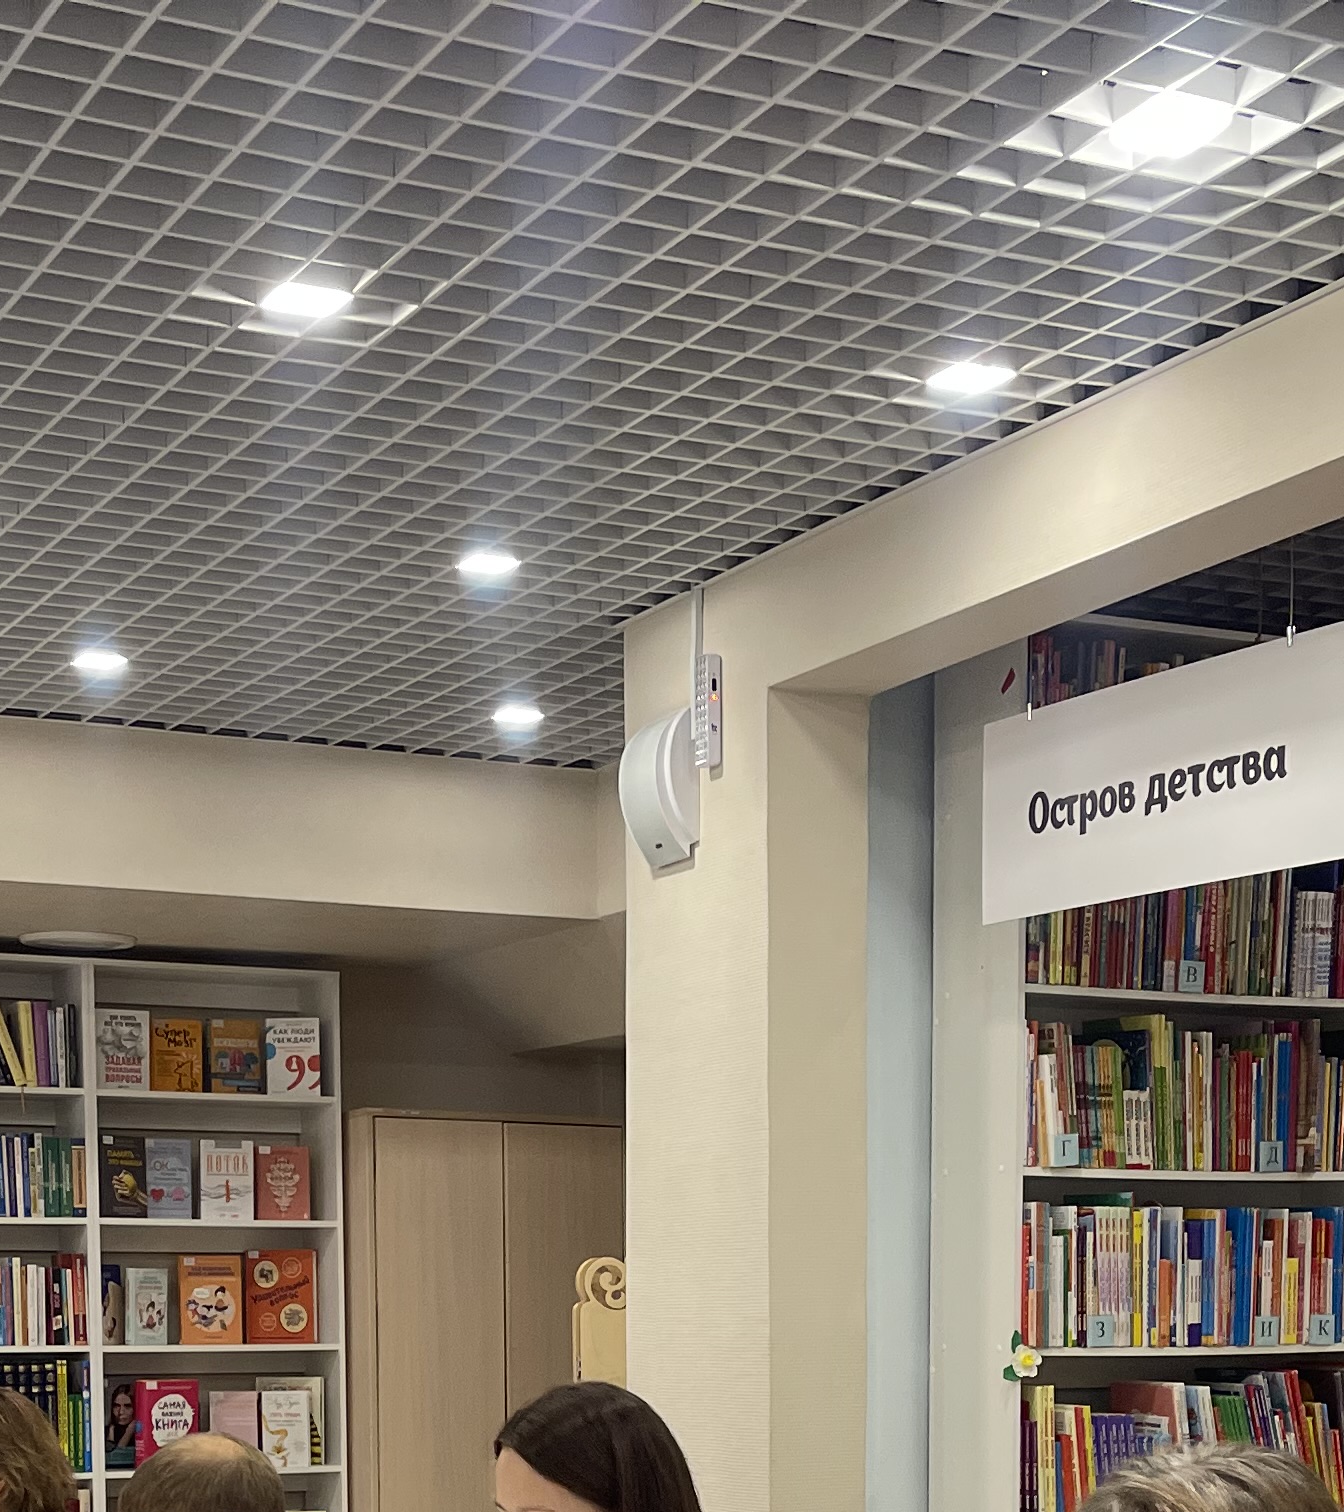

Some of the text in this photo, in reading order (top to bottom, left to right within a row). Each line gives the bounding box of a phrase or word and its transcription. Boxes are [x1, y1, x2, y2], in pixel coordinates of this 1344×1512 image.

[1028, 745, 1288, 835] Остров детства
[1185, 965, 1197, 983] В
[1062, 1139, 1072, 1157] Г
[1266, 1146, 1279, 1166] Д
[207, 1154, 249, 1173] ПОТОК
[1260, 1321, 1273, 1337] И
[1318, 1319, 1330, 1336] К
[157, 1401, 186, 1411] САМАЯ
[155, 1418, 189, 1432] КНИГА
